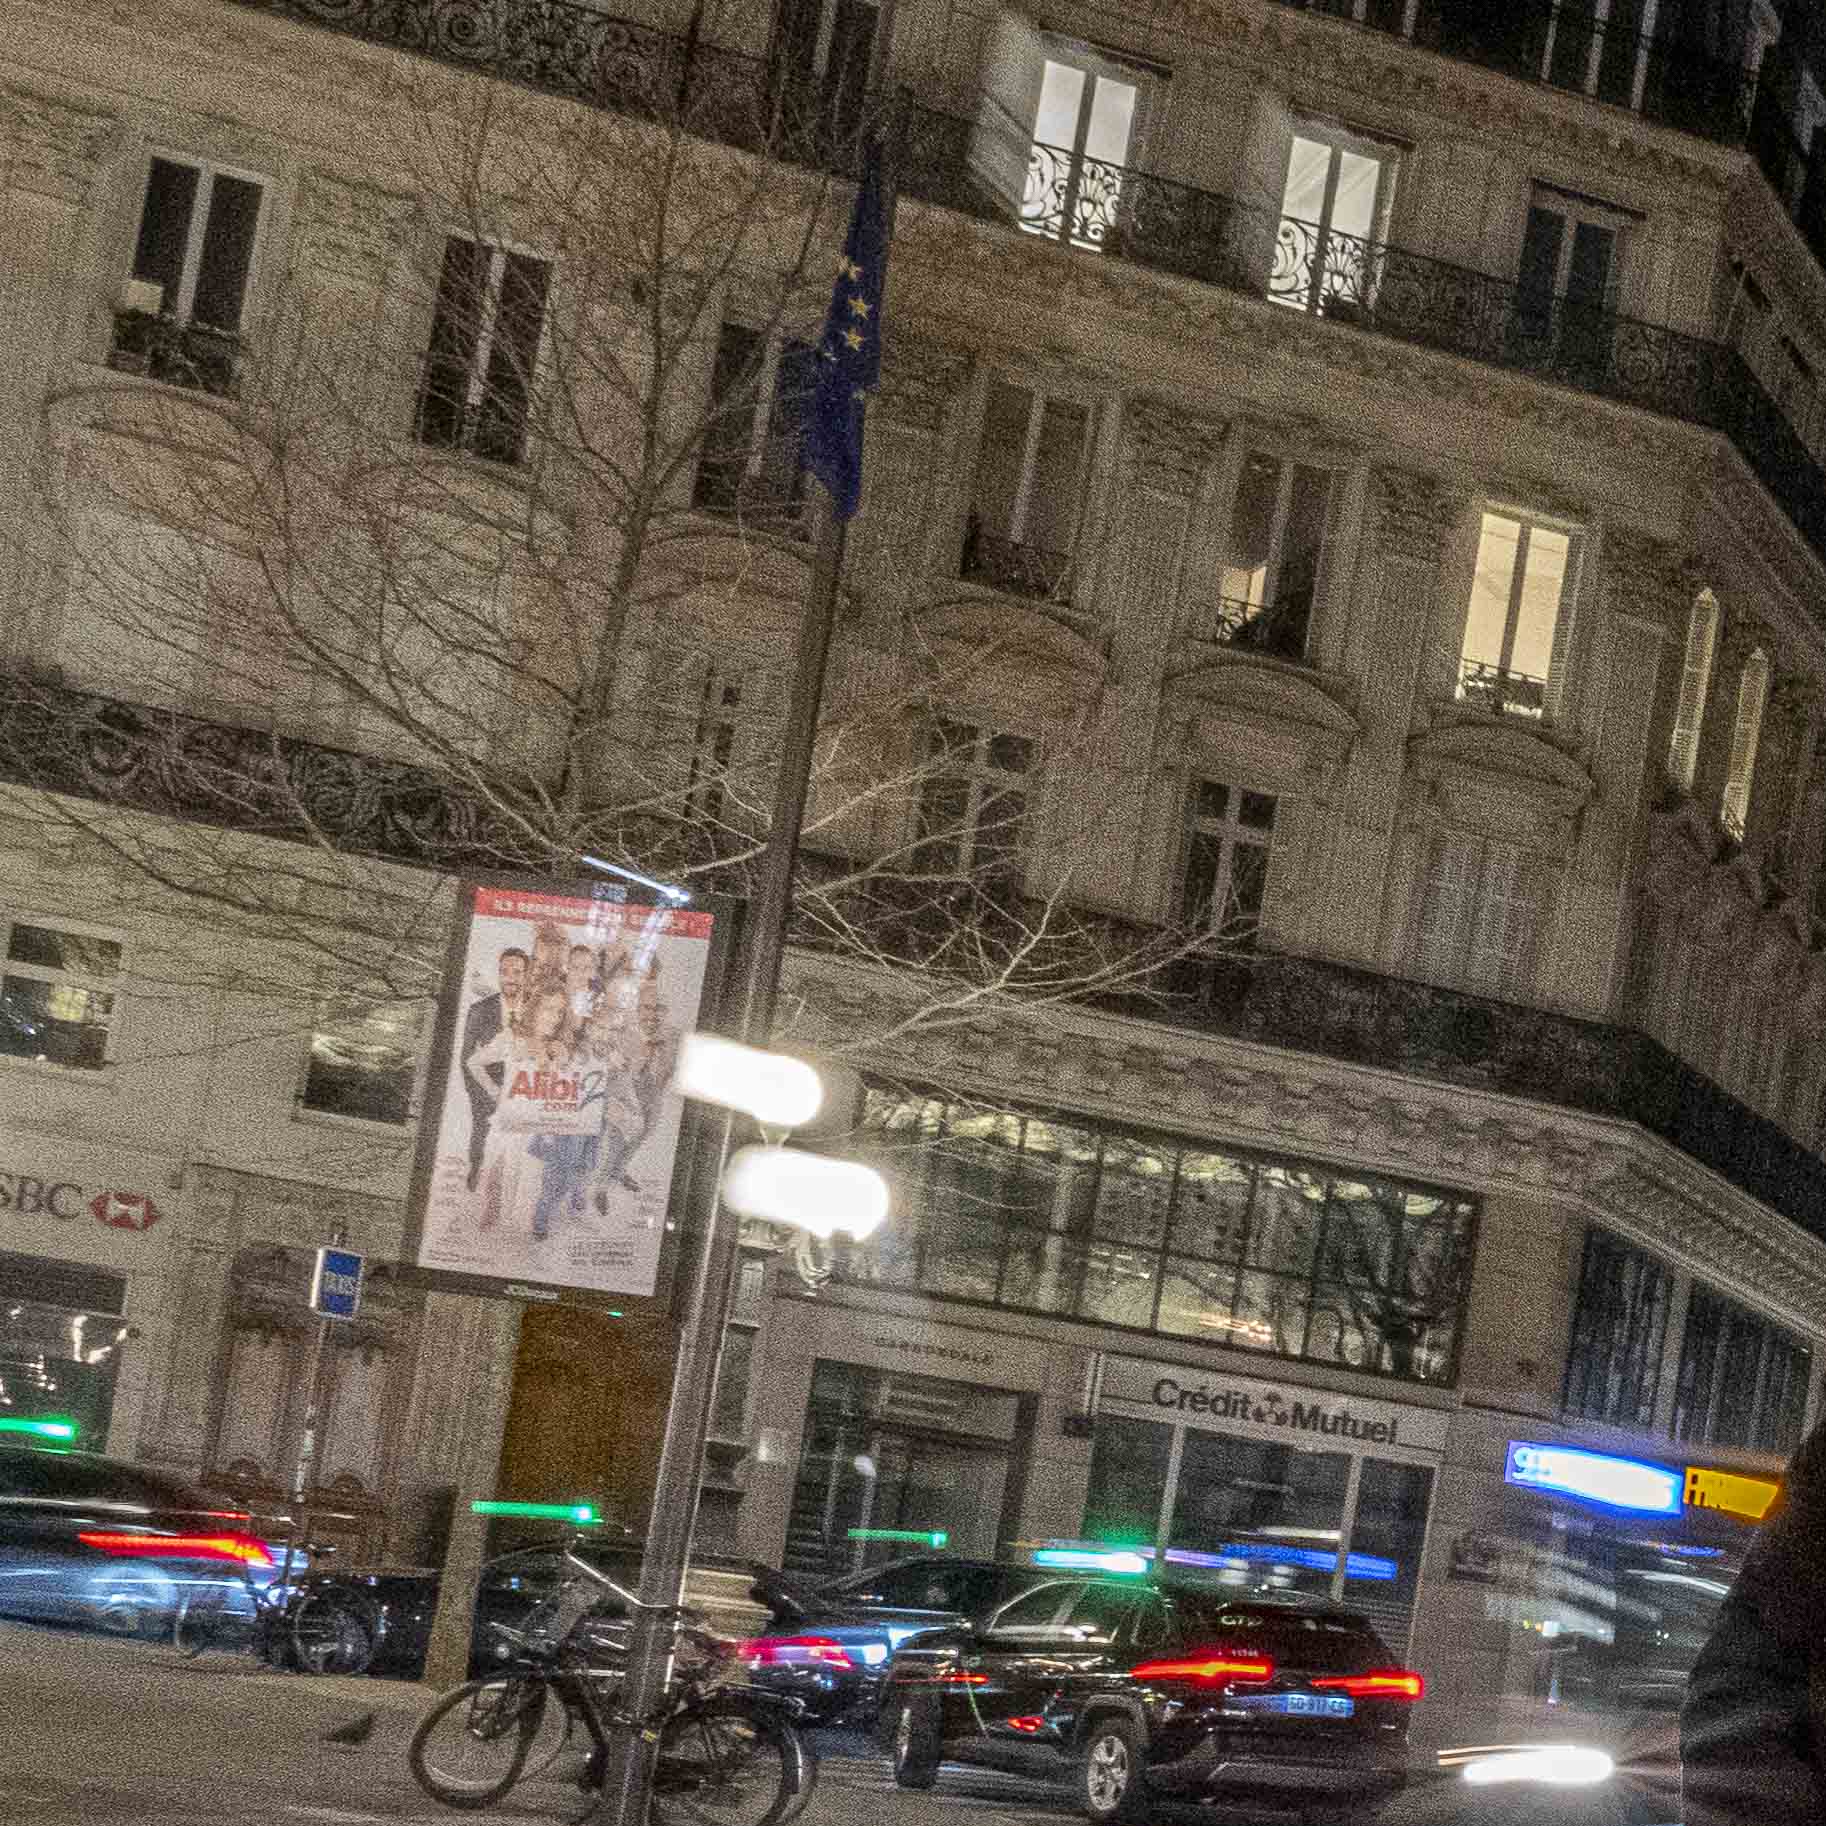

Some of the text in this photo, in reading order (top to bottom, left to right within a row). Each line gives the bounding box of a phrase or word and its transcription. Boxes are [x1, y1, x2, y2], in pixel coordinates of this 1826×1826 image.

[510, 1070, 578, 1100] Alibi
[1151, 1378, 1399, 1444] Crédit Mutuel
